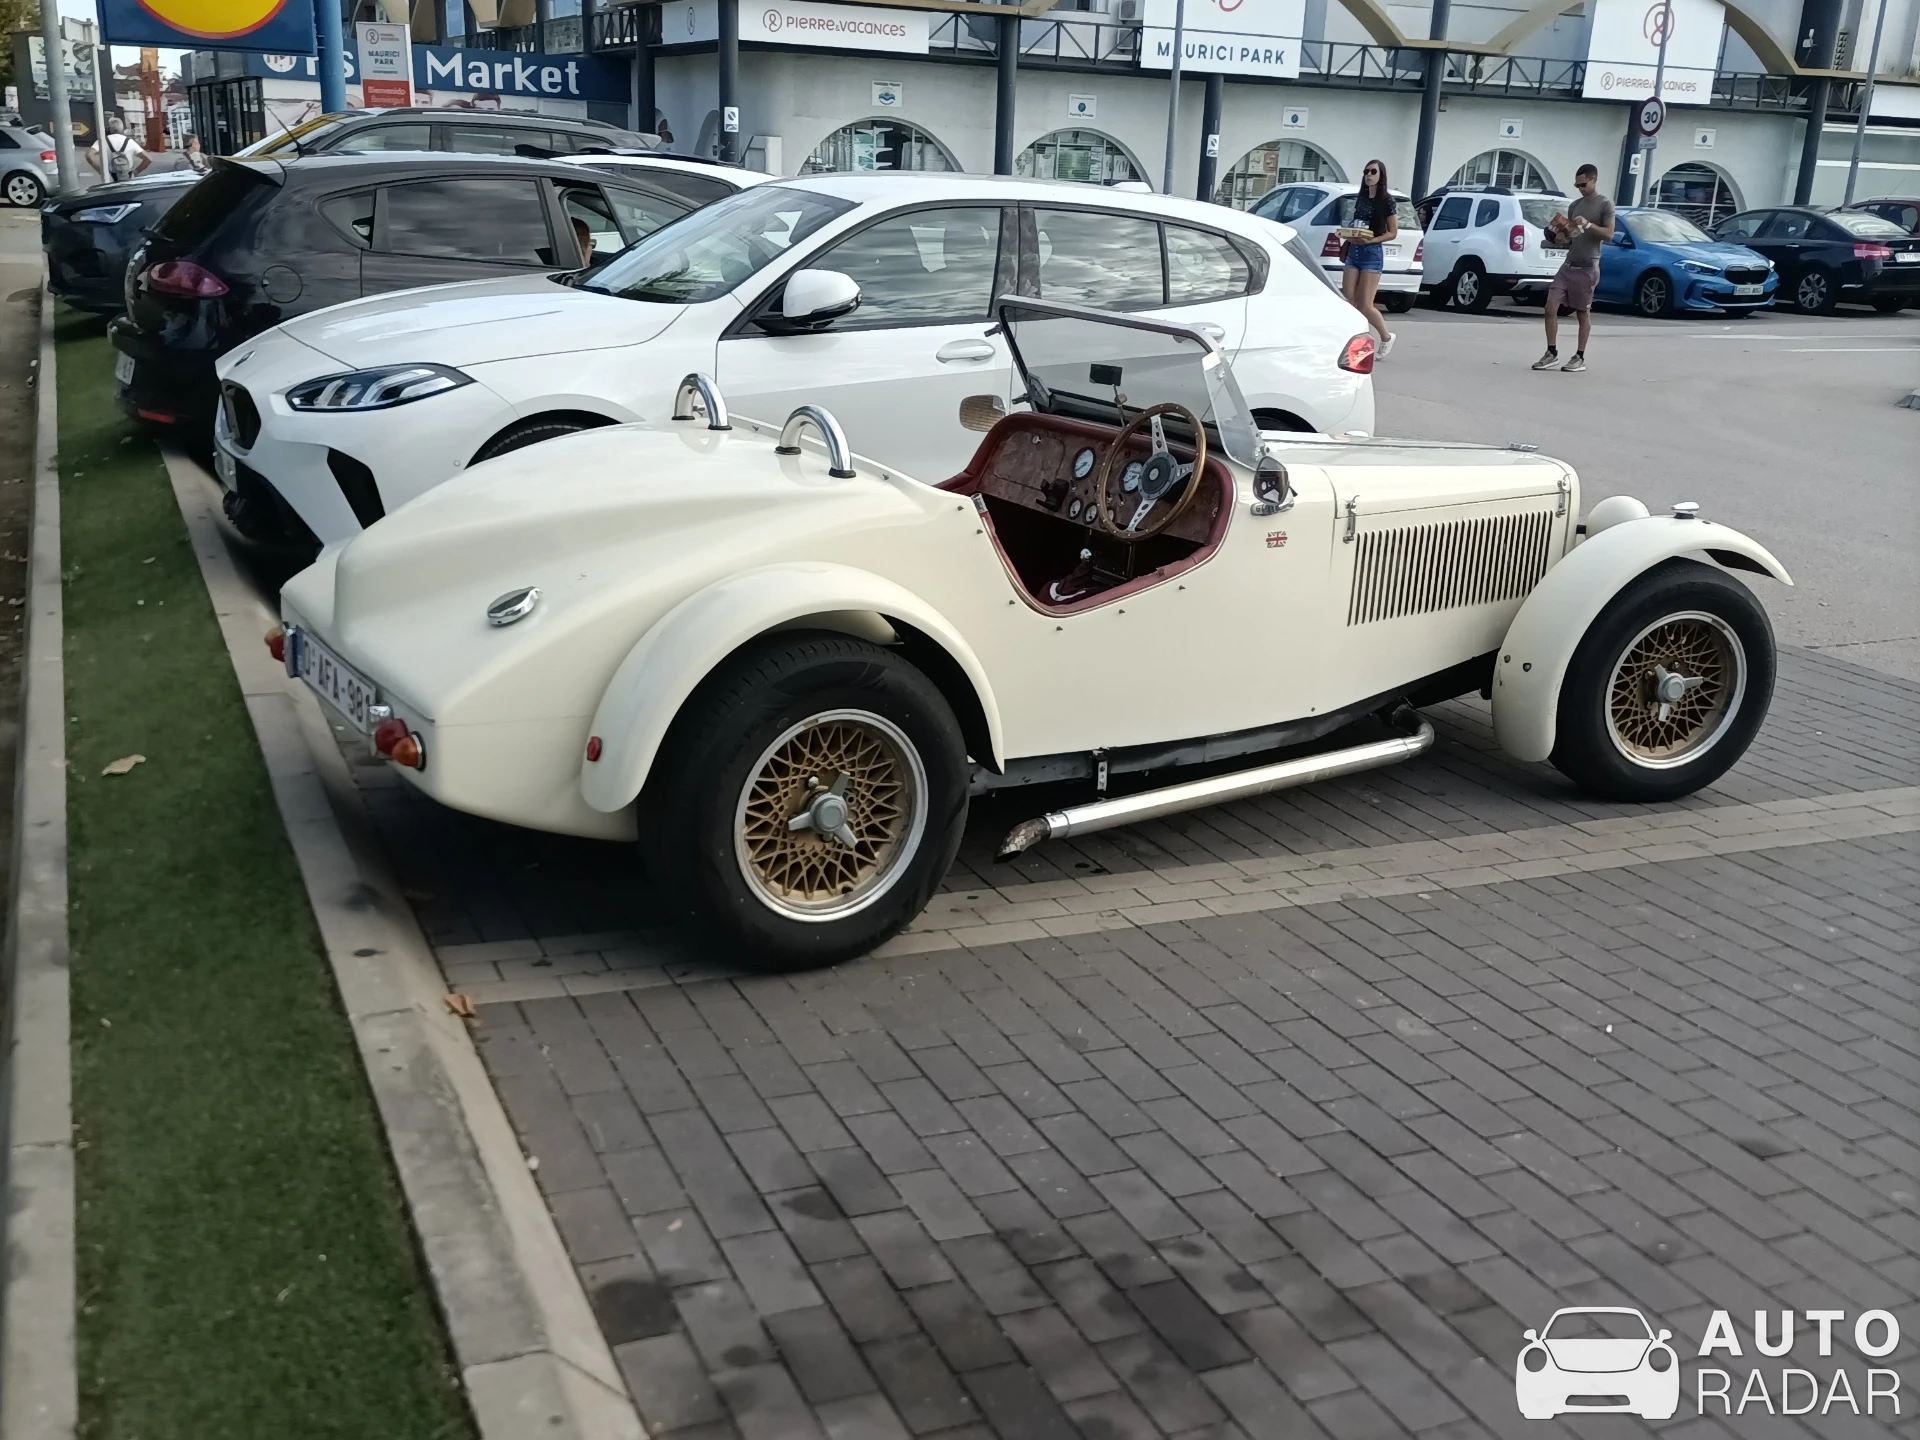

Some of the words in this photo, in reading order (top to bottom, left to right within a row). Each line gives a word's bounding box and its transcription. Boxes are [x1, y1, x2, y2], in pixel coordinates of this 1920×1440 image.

[368, 50, 400, 58] MAURICI
[1157, 41, 1234, 61] MURICI
[1240, 47, 1285, 65] PARK
[425, 50, 580, 95] Market
[1643, 110, 1659, 125] 30
